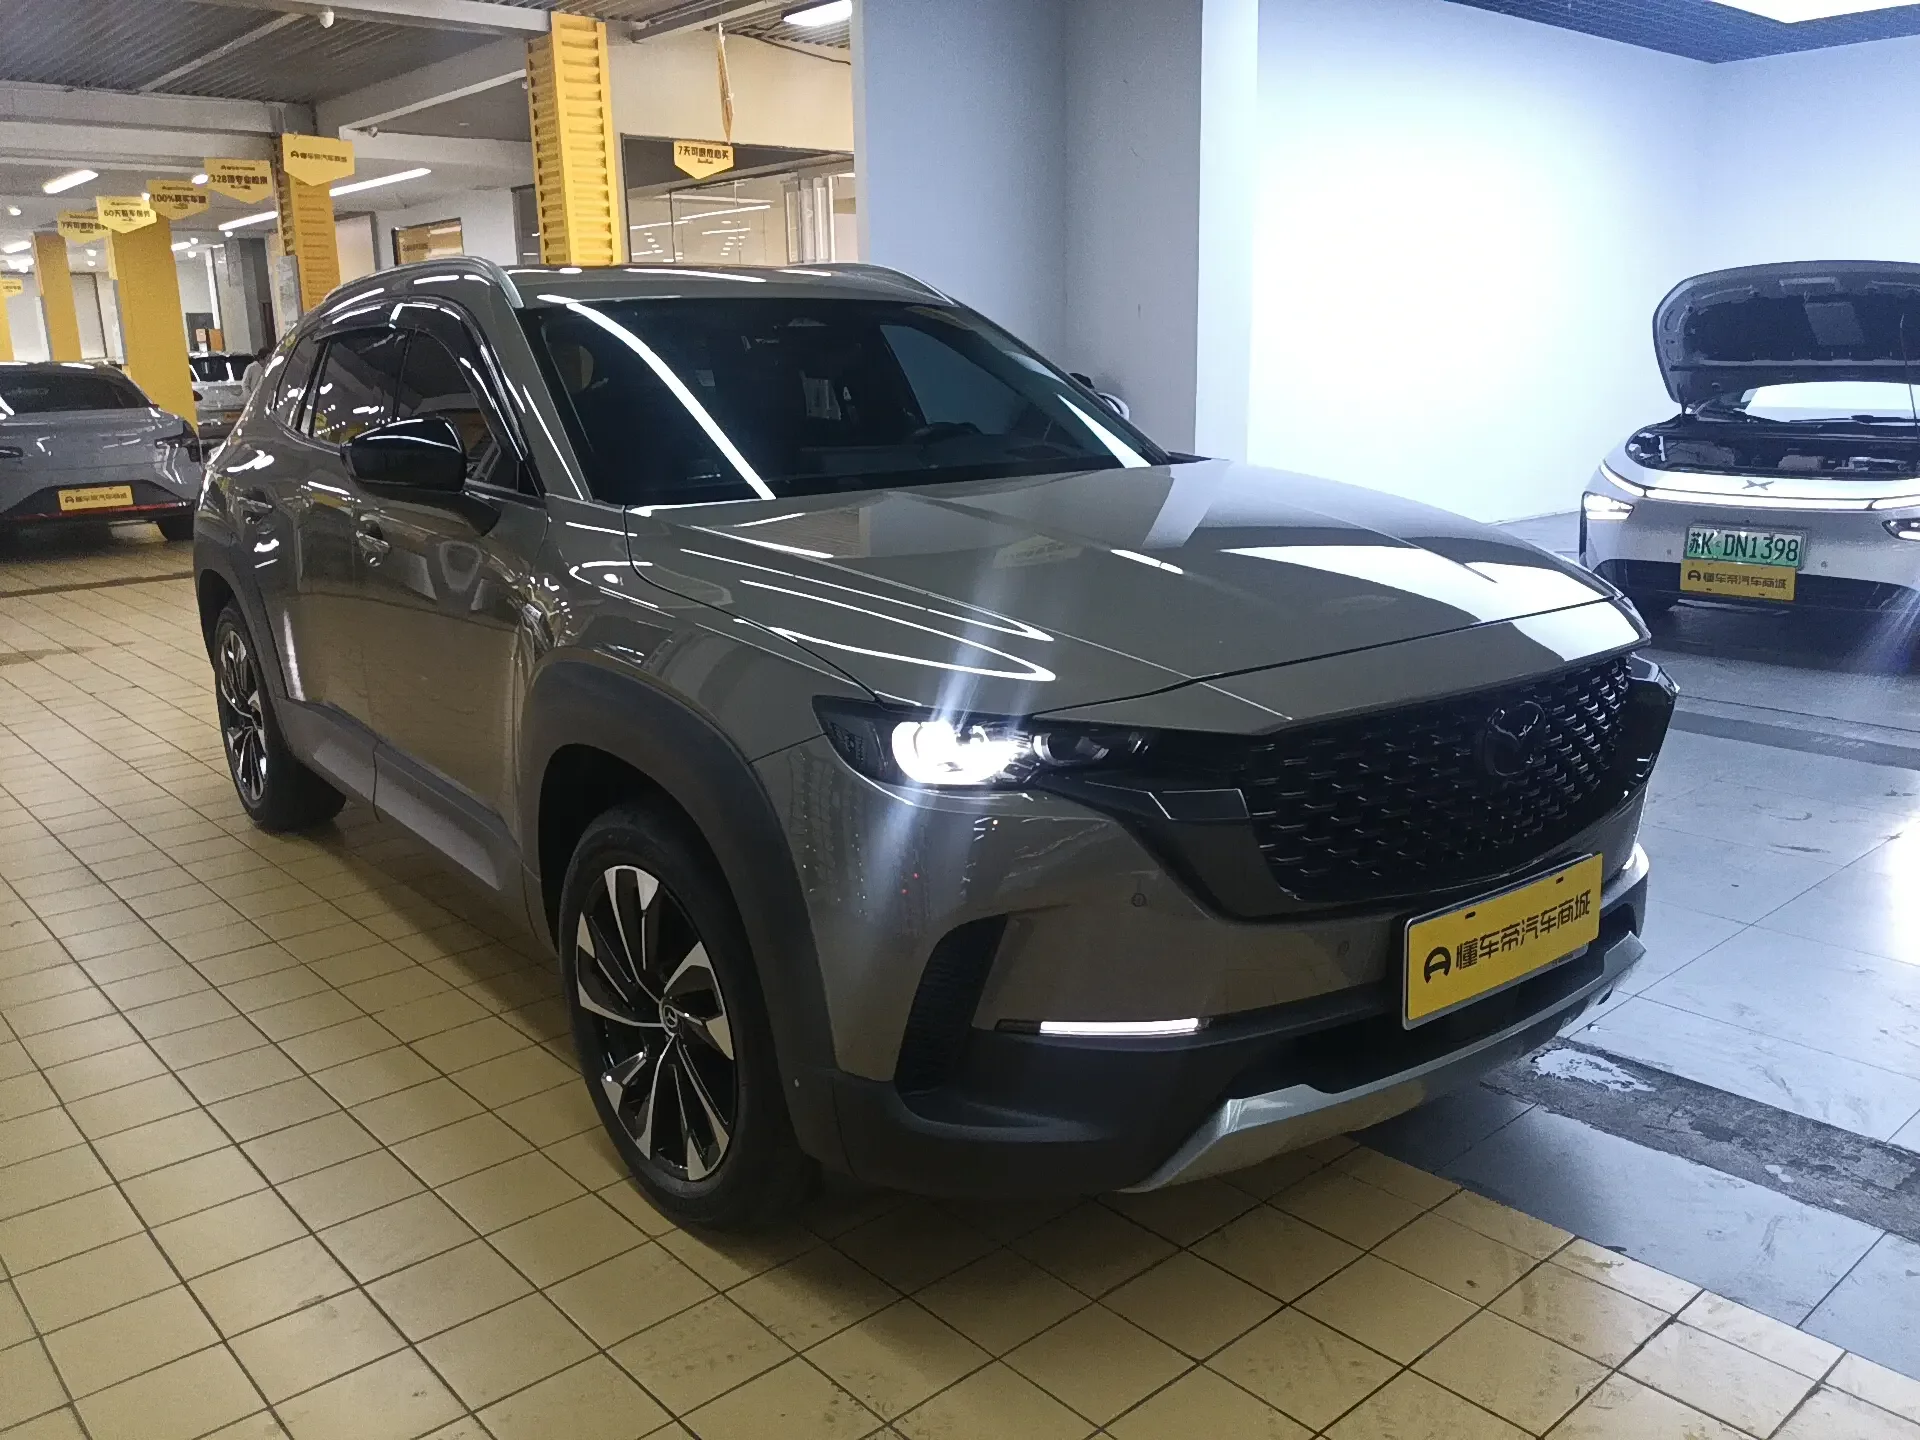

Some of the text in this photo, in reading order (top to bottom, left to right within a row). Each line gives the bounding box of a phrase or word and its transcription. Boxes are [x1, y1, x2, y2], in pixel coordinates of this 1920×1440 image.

[1688, 532, 1798, 562] 苏K DN1398
[1455, 889, 1592, 971] 懂车帝汽车商城
